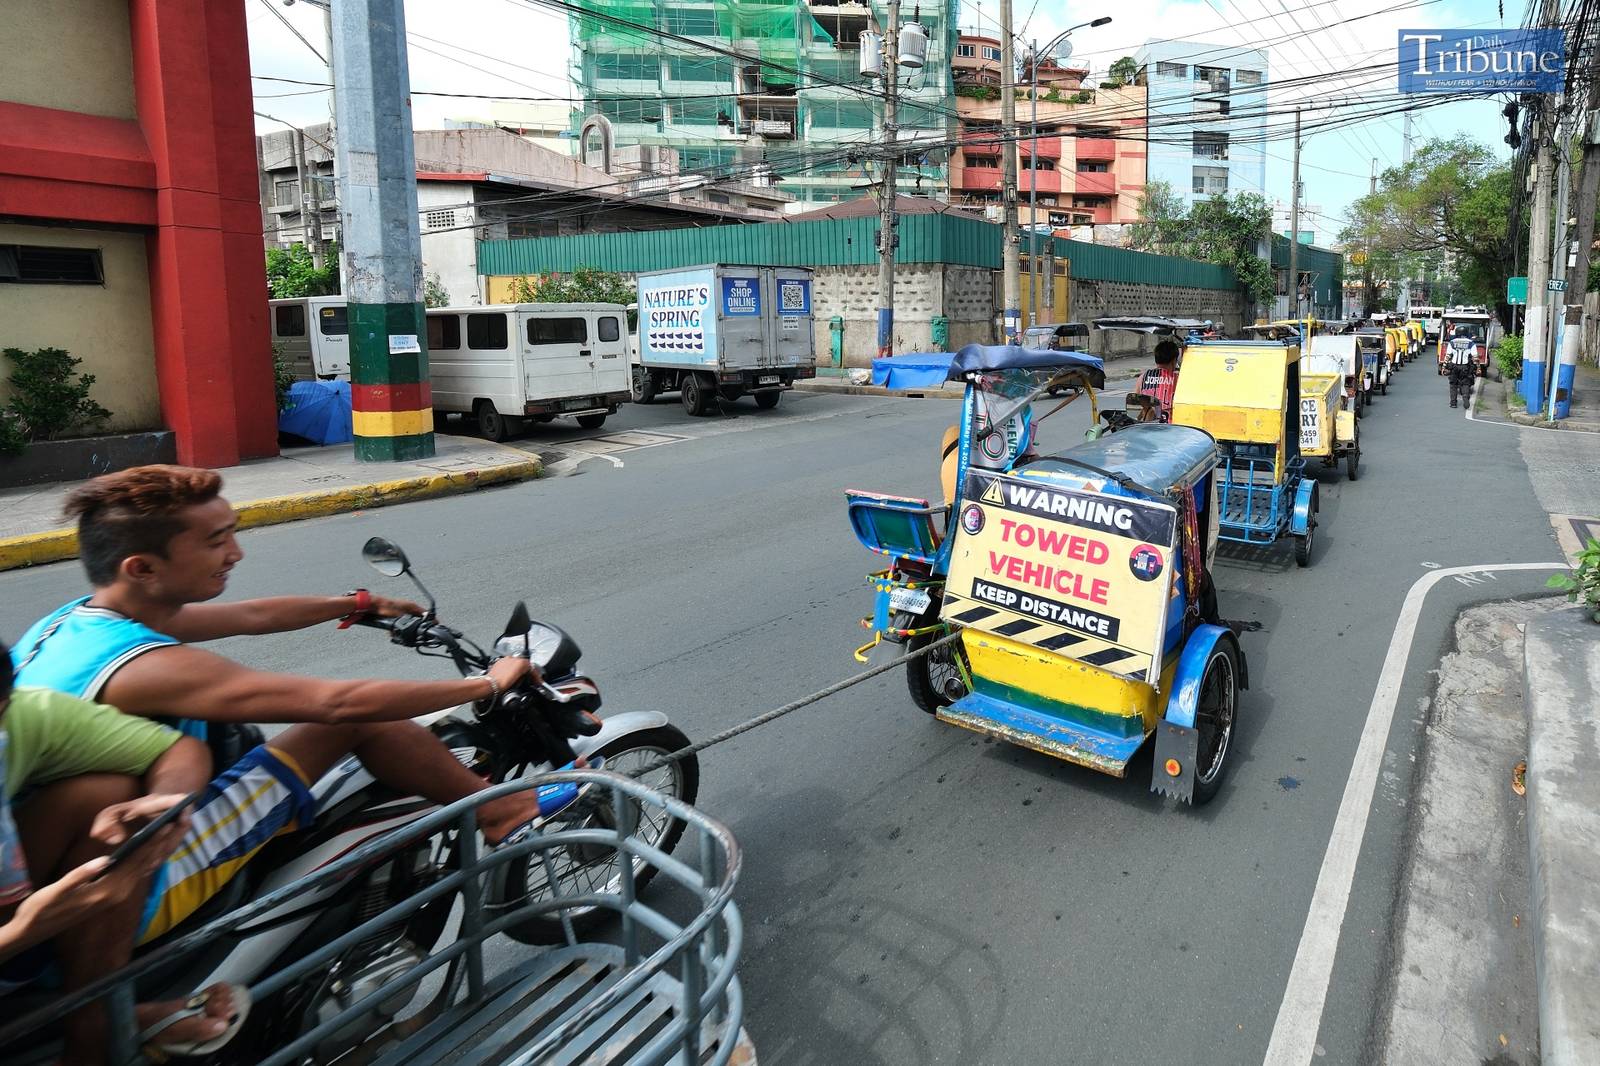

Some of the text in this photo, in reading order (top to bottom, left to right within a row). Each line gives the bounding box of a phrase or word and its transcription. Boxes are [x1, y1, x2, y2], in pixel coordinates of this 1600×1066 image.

[731, 287, 752, 297] SHOP
[1546, 280, 1564, 290] EREZ
[644, 287, 708, 308] NATURE'S
[728, 297, 756, 307] ONLINE
[651, 310, 700, 328] SPRING
[1145, 376, 1174, 385] JORDAN
[1009, 485, 1134, 530] WARNING
[1000, 519, 1110, 565] TOWED
[989, 551, 1110, 605] VEHICLE
[975, 583, 1110, 635] KEEP DISTANCE
